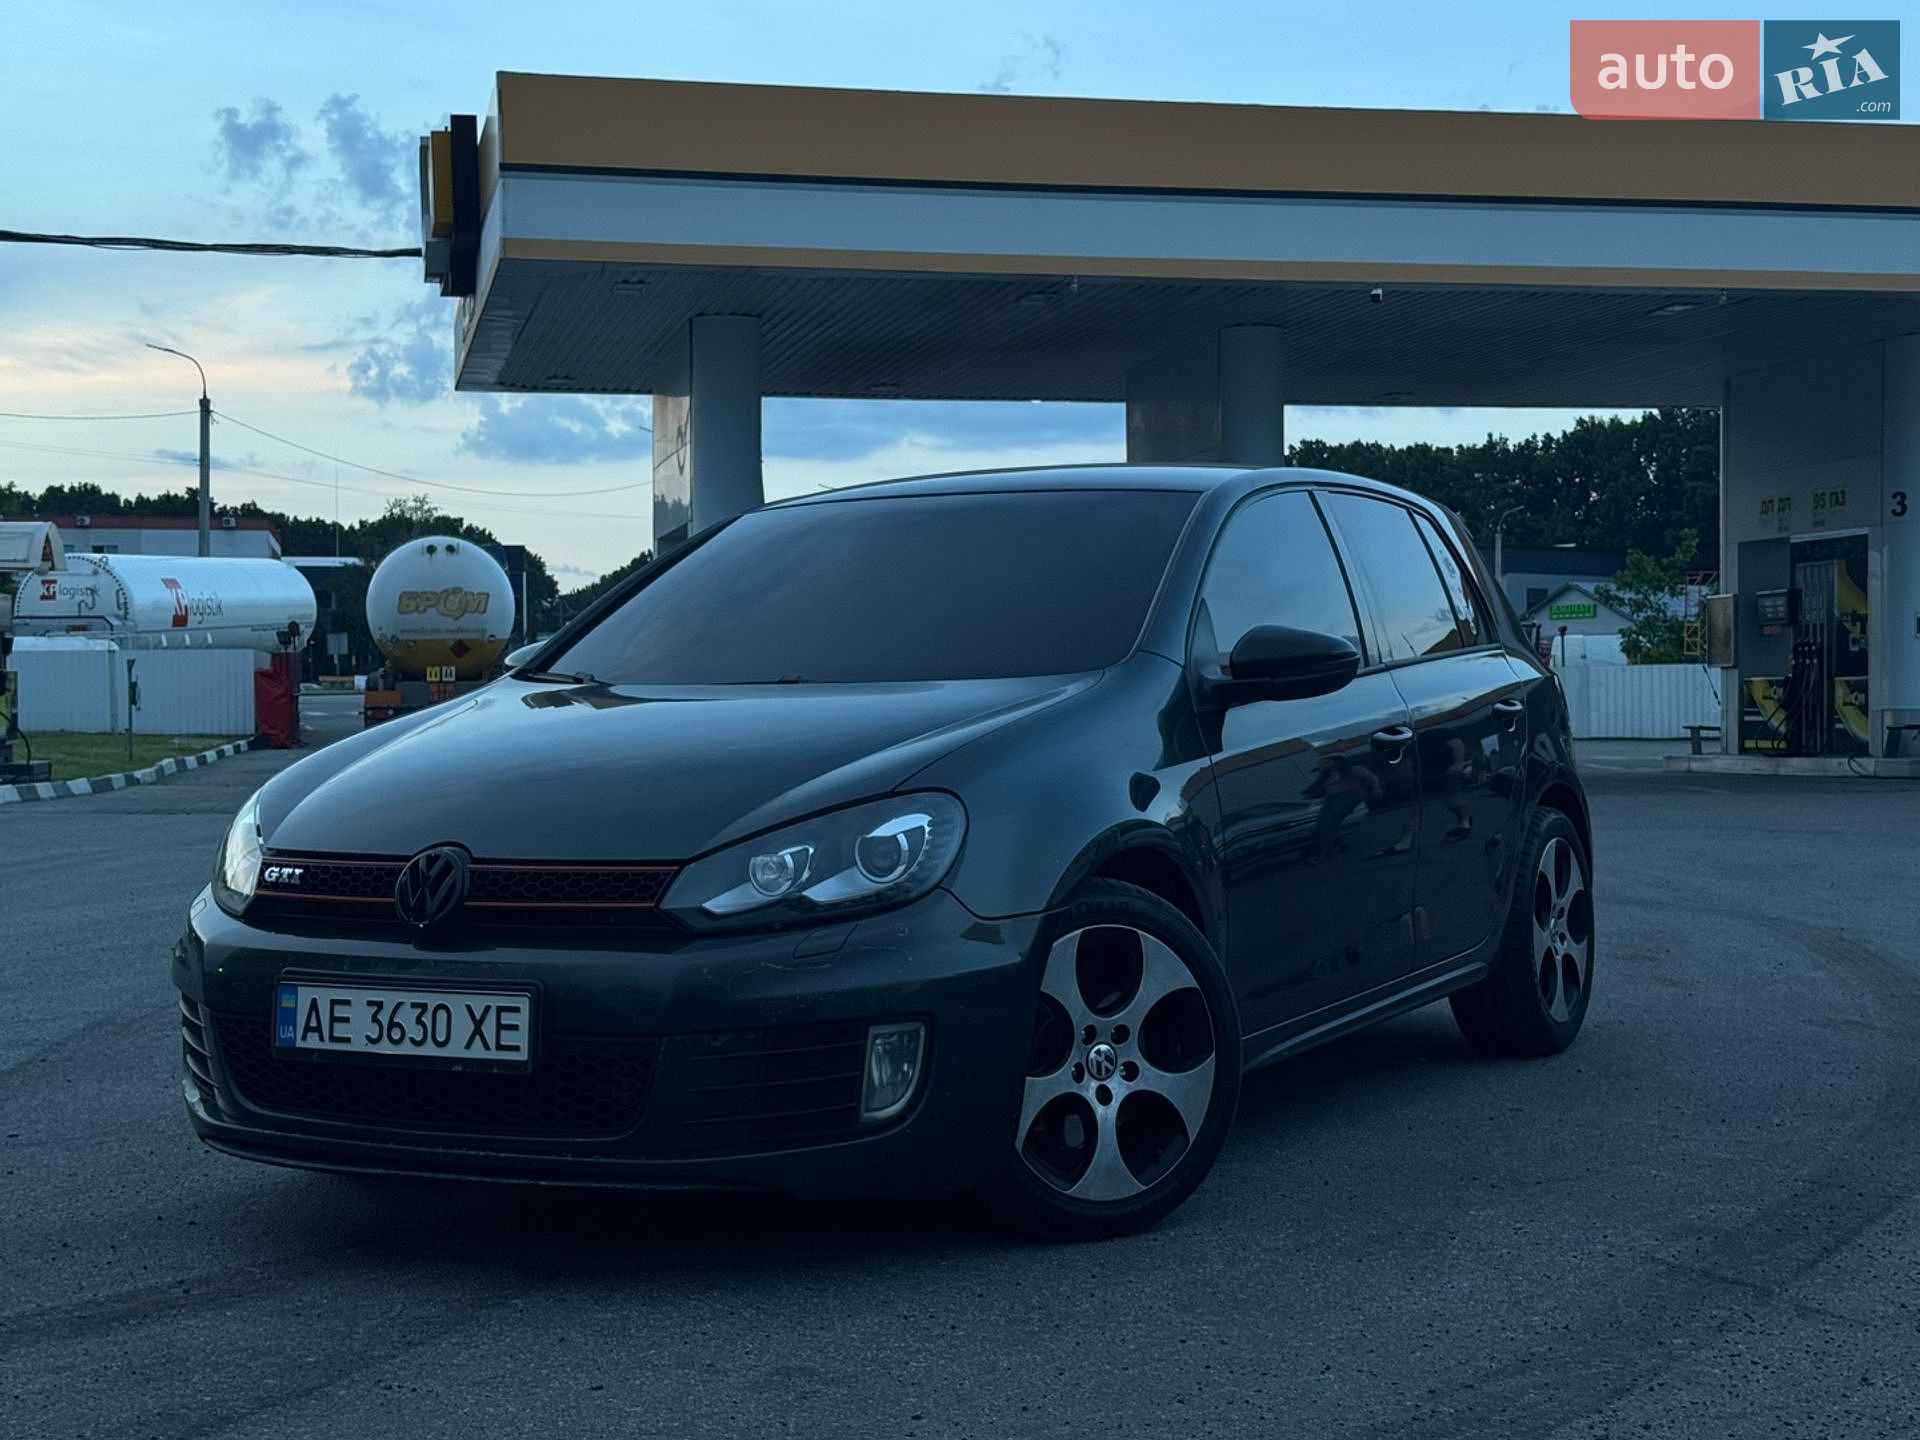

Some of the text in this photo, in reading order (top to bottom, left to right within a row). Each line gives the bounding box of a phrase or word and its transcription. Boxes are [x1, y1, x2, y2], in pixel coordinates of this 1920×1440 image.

[1891, 491, 1908, 517] 3
[264, 866, 304, 884] GTI
[279, 1024, 295, 1040] UA
[301, 996, 522, 1052] AE 3630 XE
